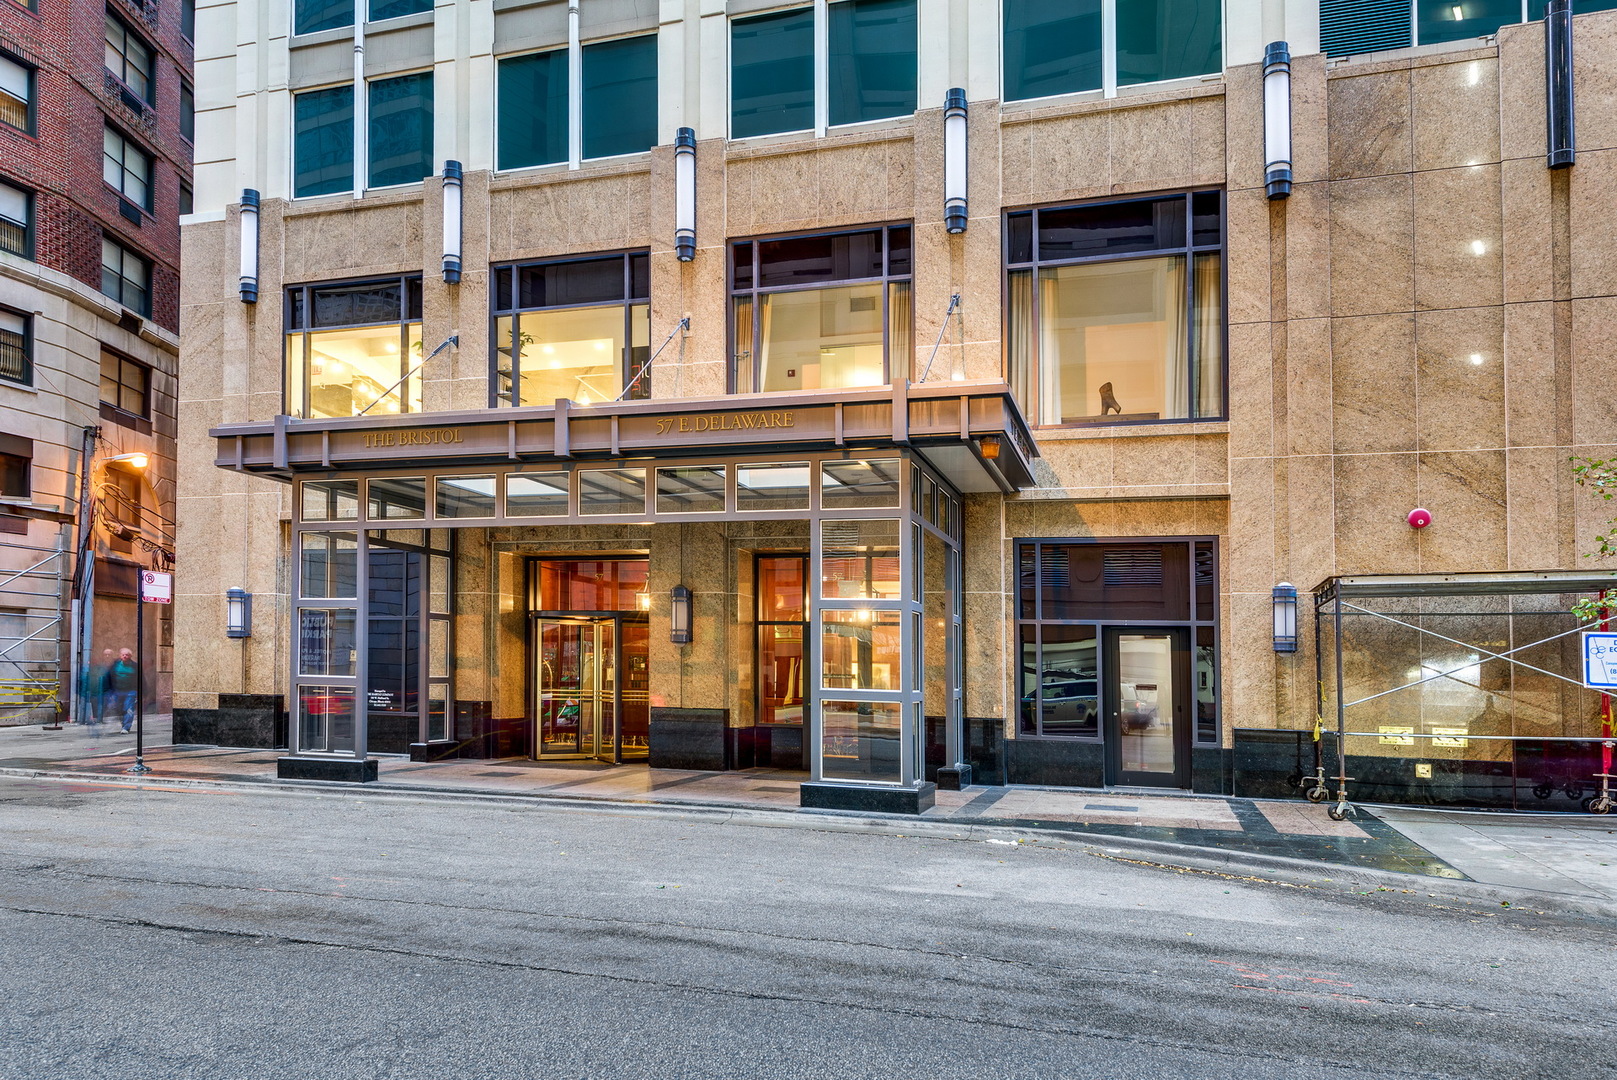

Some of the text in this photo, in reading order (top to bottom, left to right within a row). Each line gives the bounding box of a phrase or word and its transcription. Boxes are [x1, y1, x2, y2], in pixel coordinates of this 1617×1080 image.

[656, 412, 794, 434] 57 E. DELAWARE
[363, 429, 464, 448] THE BRISTOL
[595, 573, 604, 581] 57
